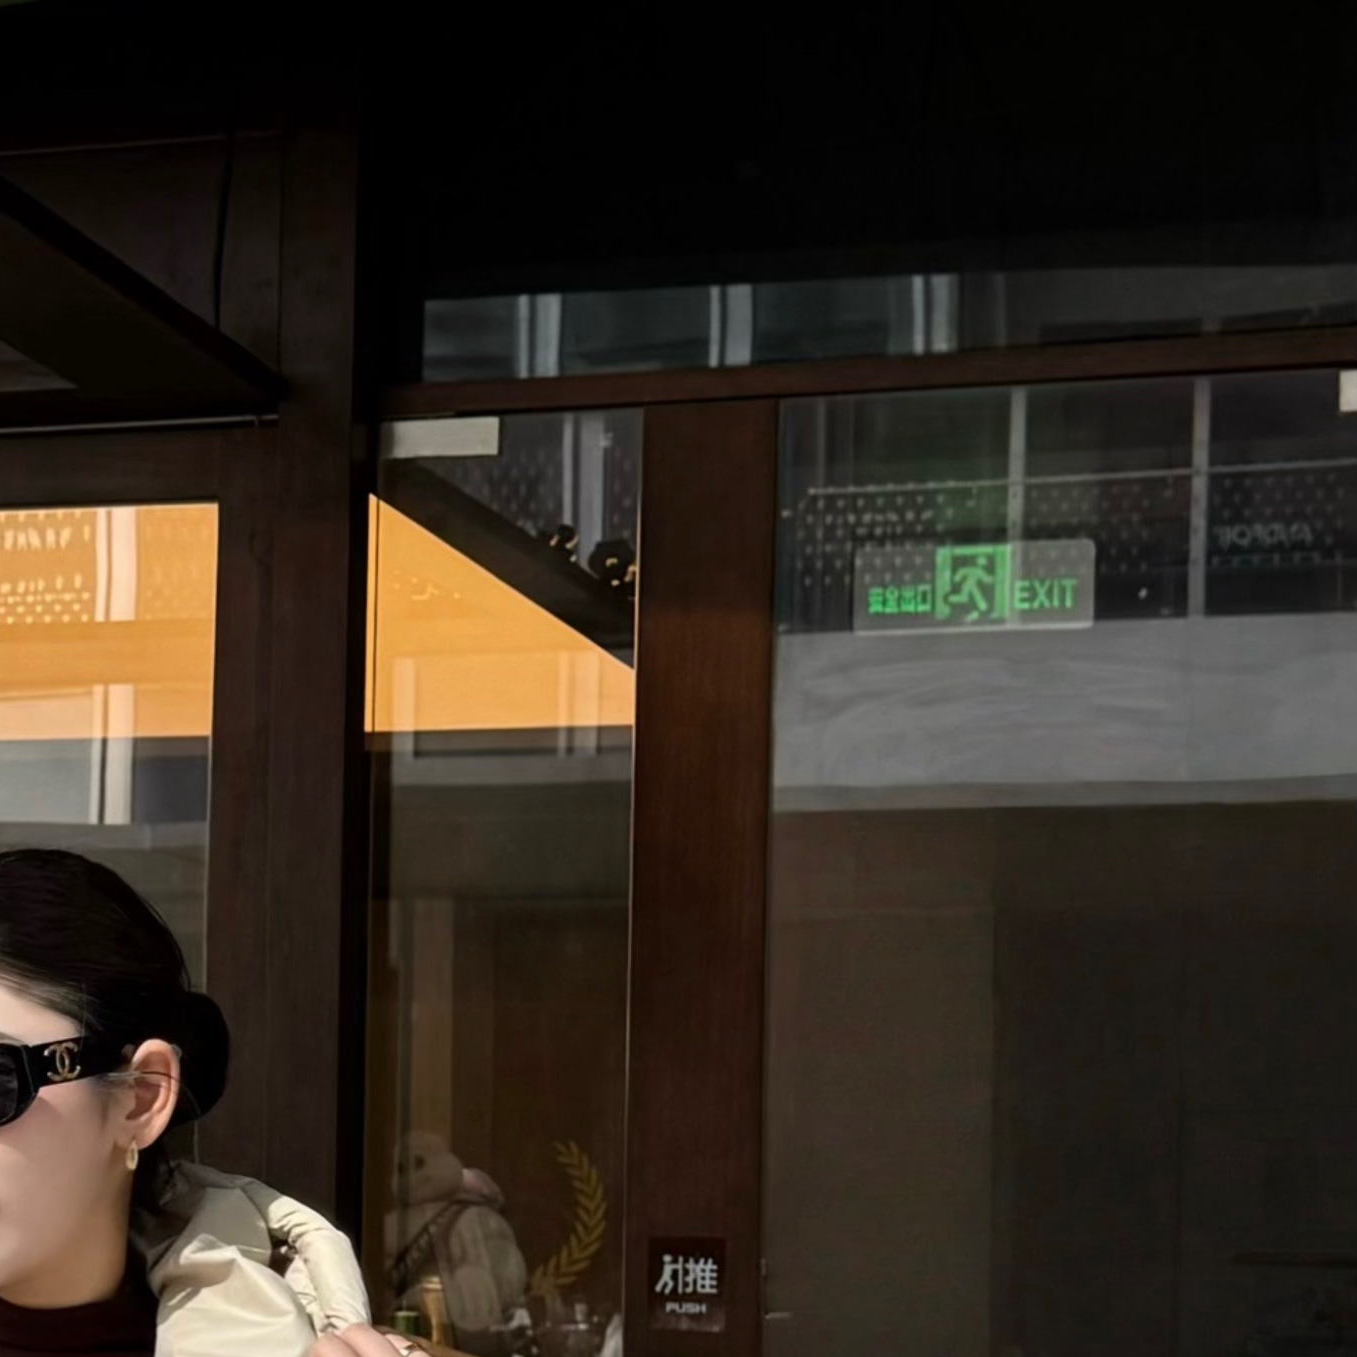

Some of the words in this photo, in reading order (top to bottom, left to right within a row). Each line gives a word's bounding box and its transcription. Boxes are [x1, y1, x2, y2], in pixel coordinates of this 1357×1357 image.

[1014, 578, 1077, 610] EXIT
[684, 1257, 719, 1294] 推
[665, 1302, 706, 1314] PUSH
